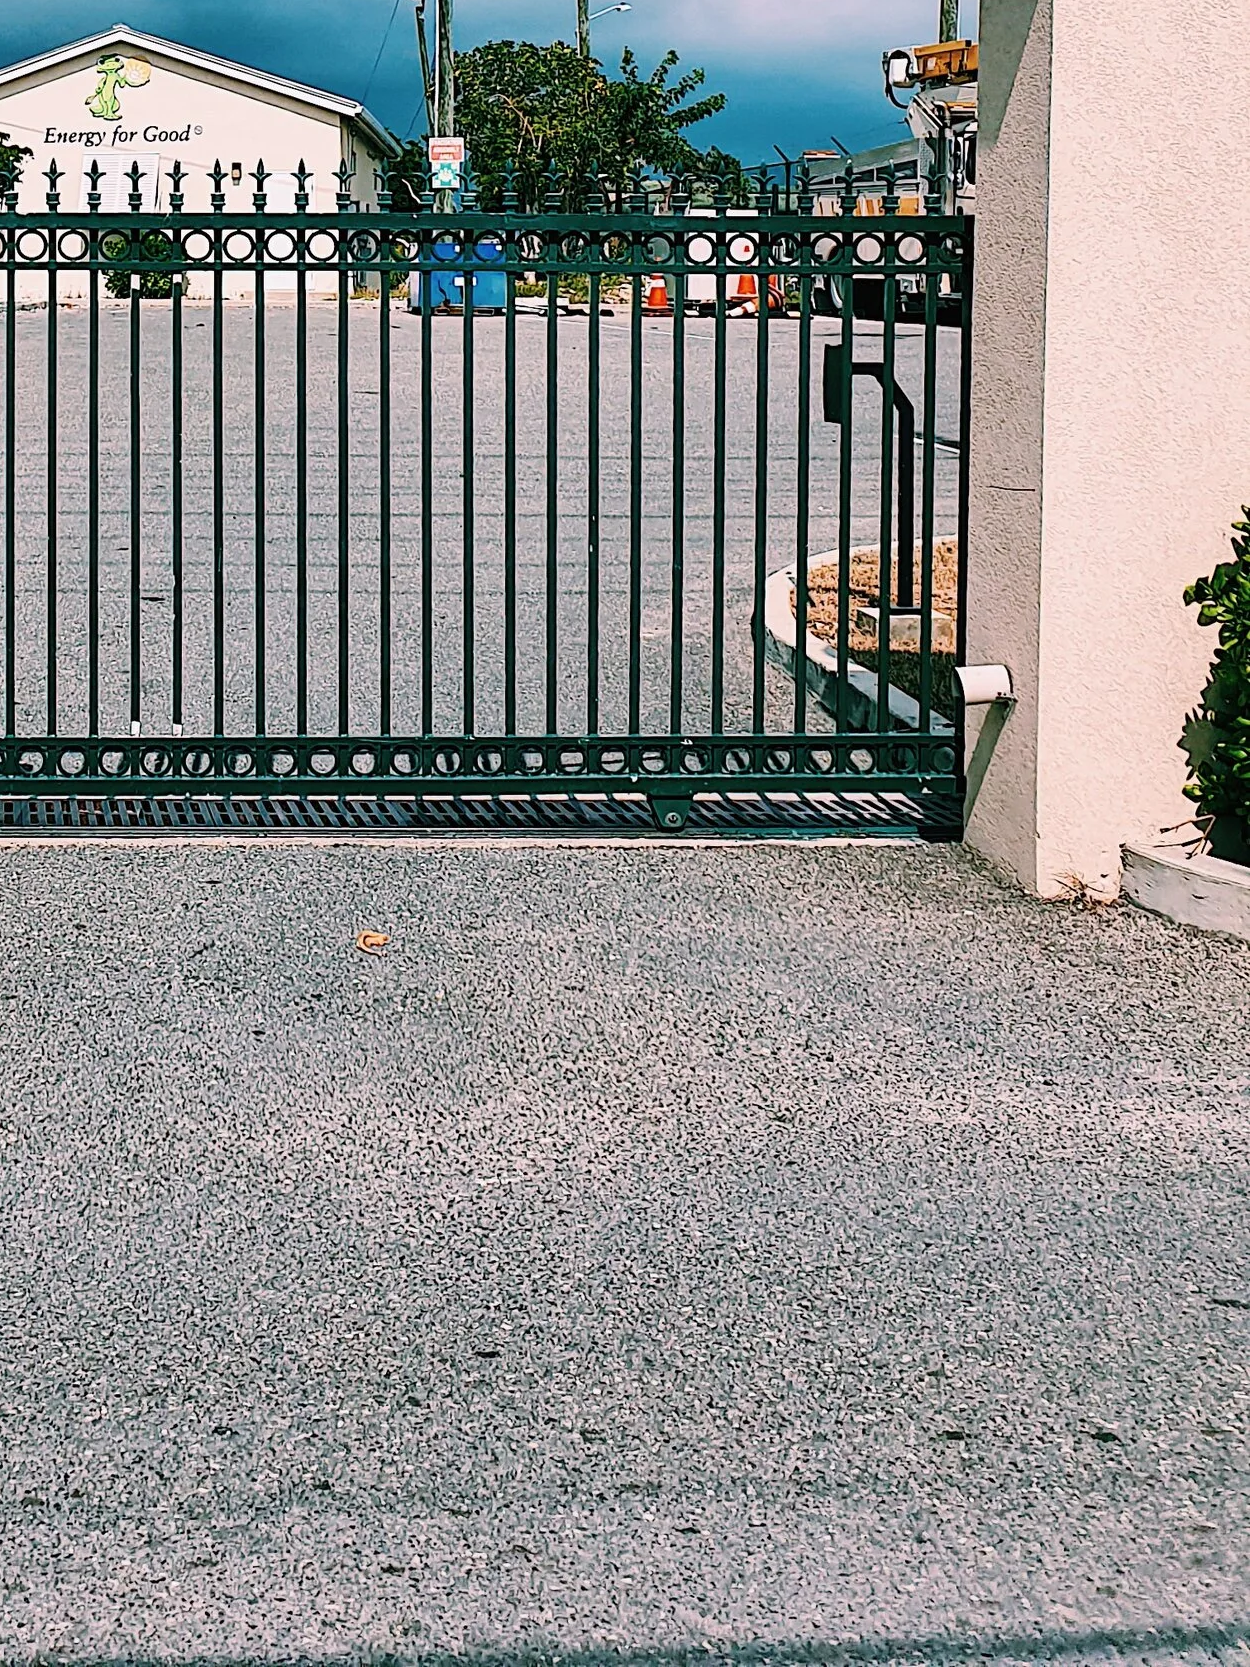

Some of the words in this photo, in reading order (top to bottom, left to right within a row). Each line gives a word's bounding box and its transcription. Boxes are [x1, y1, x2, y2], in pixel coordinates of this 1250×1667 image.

[43, 127, 107, 147] Energy
[111, 124, 138, 147] for
[143, 124, 191, 142] Good
